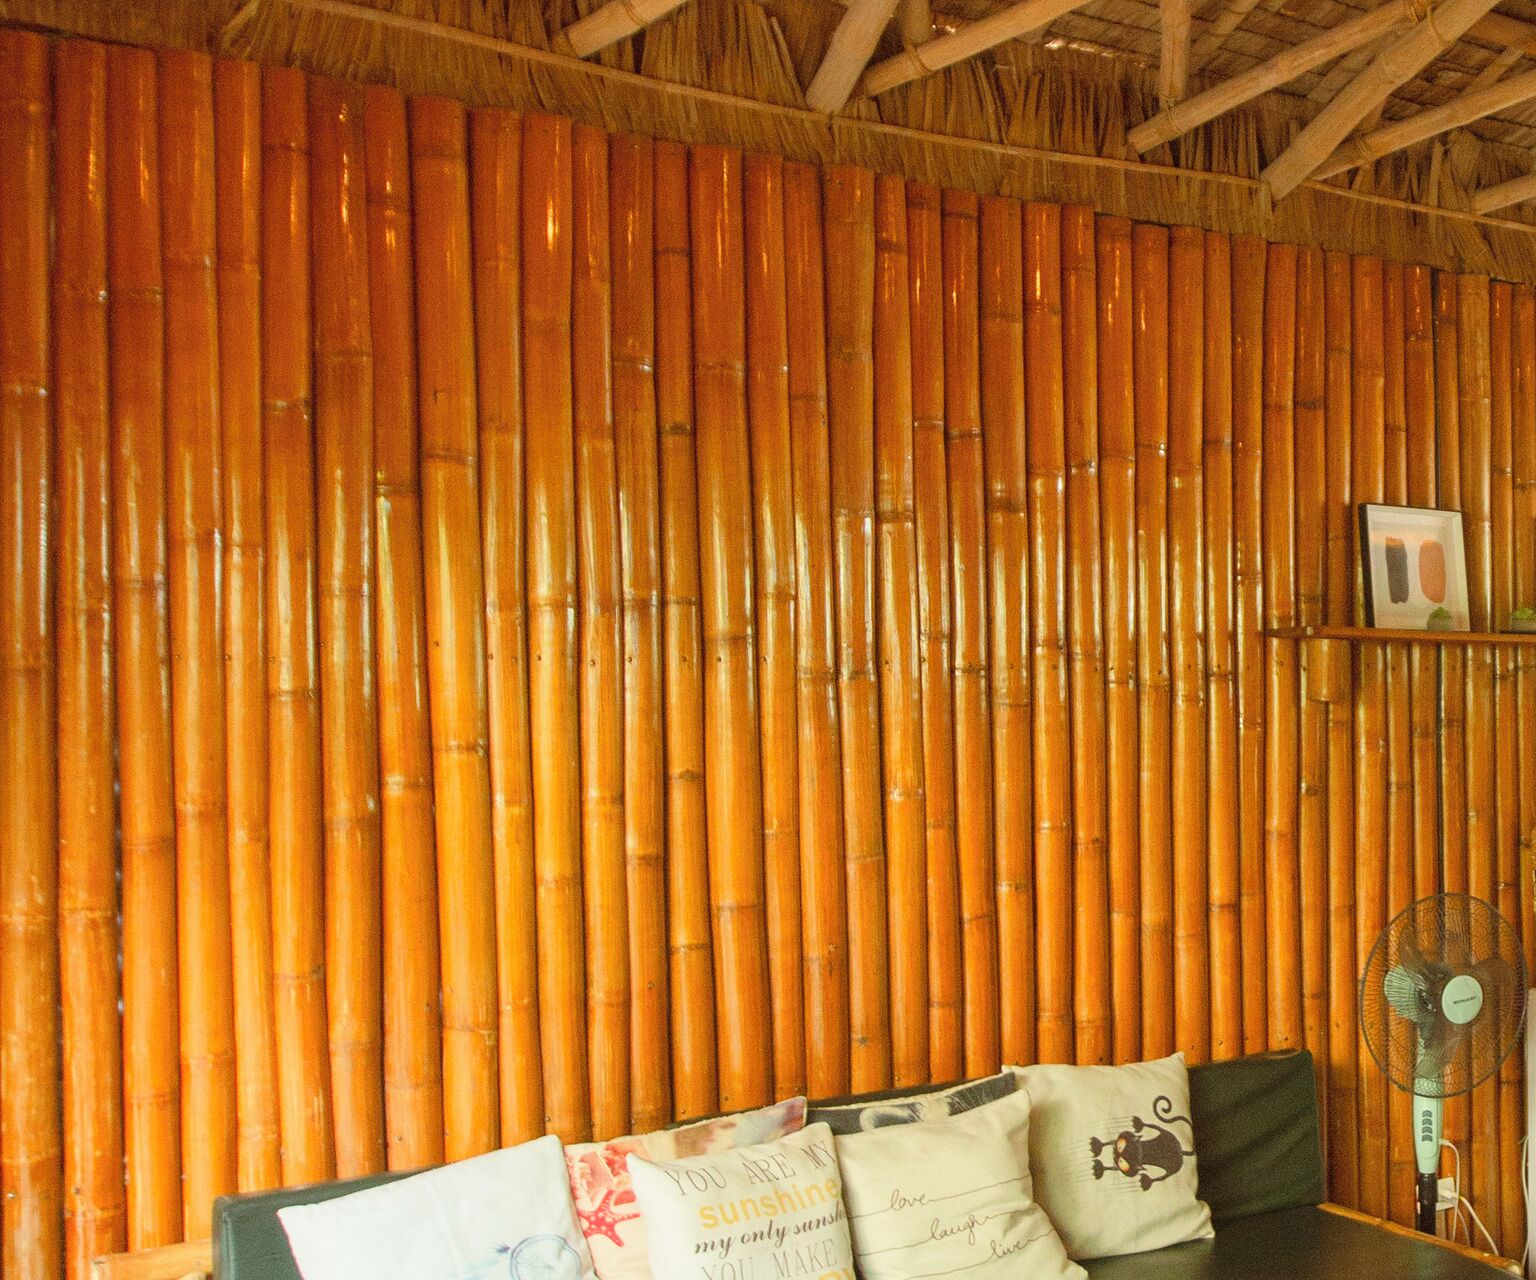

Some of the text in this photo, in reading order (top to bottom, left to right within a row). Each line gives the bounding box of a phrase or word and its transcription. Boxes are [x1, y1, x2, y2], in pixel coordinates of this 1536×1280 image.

[664, 1139, 837, 1196] YOU ARE MY
[699, 1177, 841, 1229] sunshine
[890, 1189, 928, 1211] love
[695, 1236, 732, 1259] my
[741, 1220, 787, 1248] only
[930, 1218, 988, 1245] laugh
[990, 1240, 1028, 1258] live
[772, 1238, 839, 1280] MAKE
